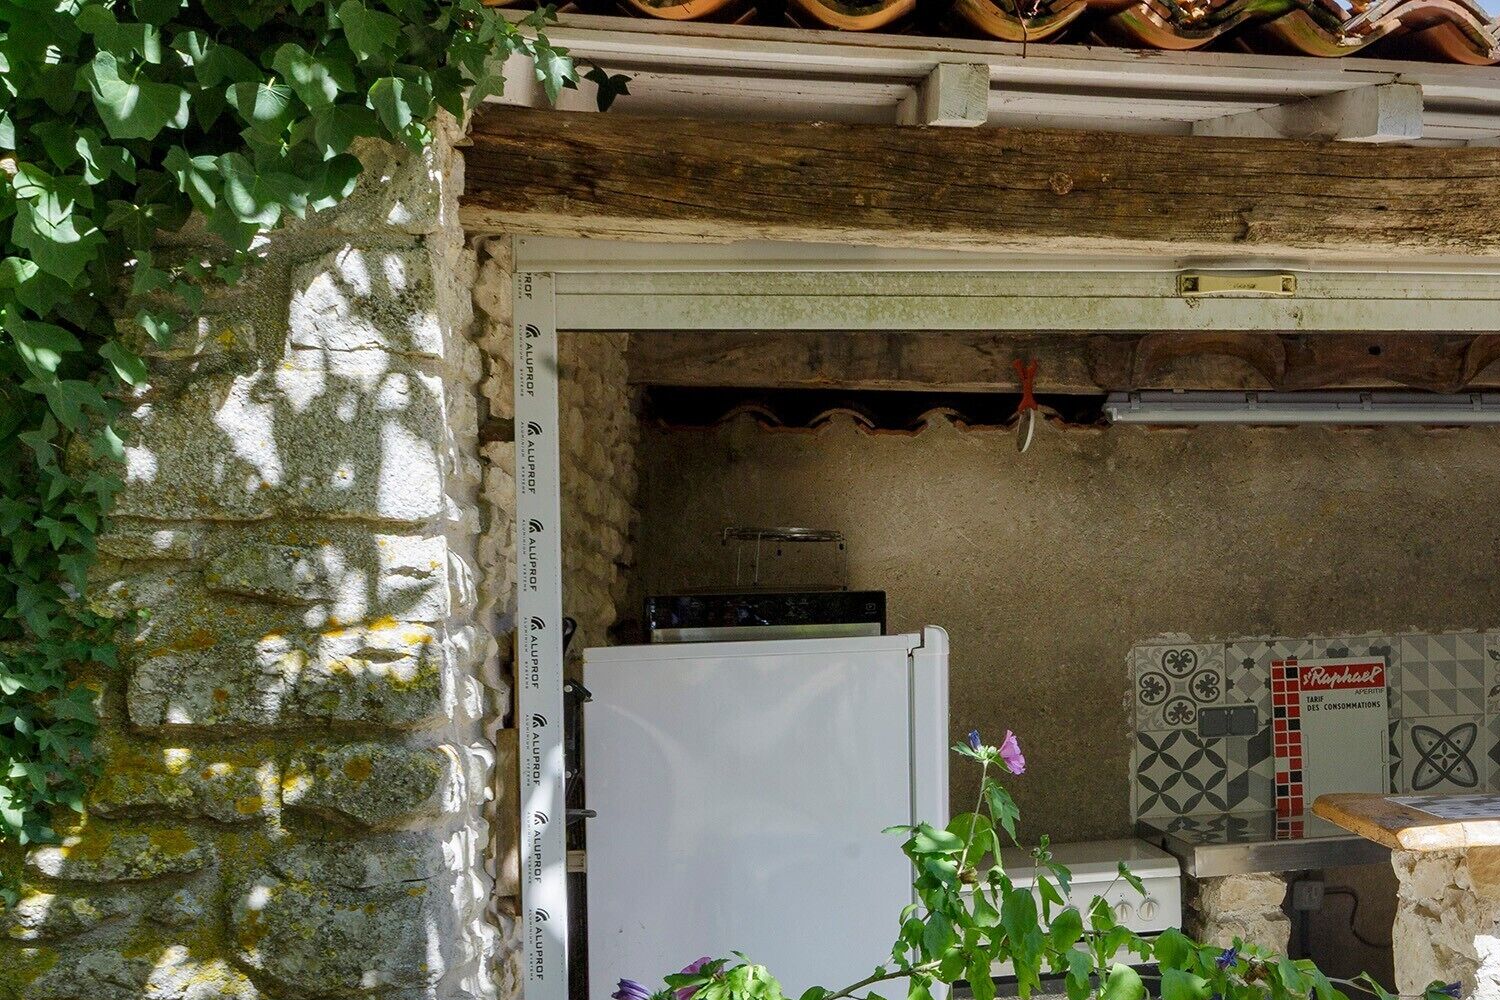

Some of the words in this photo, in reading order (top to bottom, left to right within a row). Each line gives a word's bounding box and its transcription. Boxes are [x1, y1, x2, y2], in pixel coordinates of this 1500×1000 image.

[525, 342, 535, 397] ALUPROF
[527, 440, 536, 494] ALUPROF
[529, 537, 537, 592] ALUPROF
[531, 635, 539, 689] ALUPROF
[1306, 695, 1324, 703] TARIF
[1307, 704, 1320, 712] DES
[1324, 701, 1381, 711] CONSOMMATIONS
[532, 732, 540, 786] ALUPROF
[535, 926, 543, 980] ALUPROF
